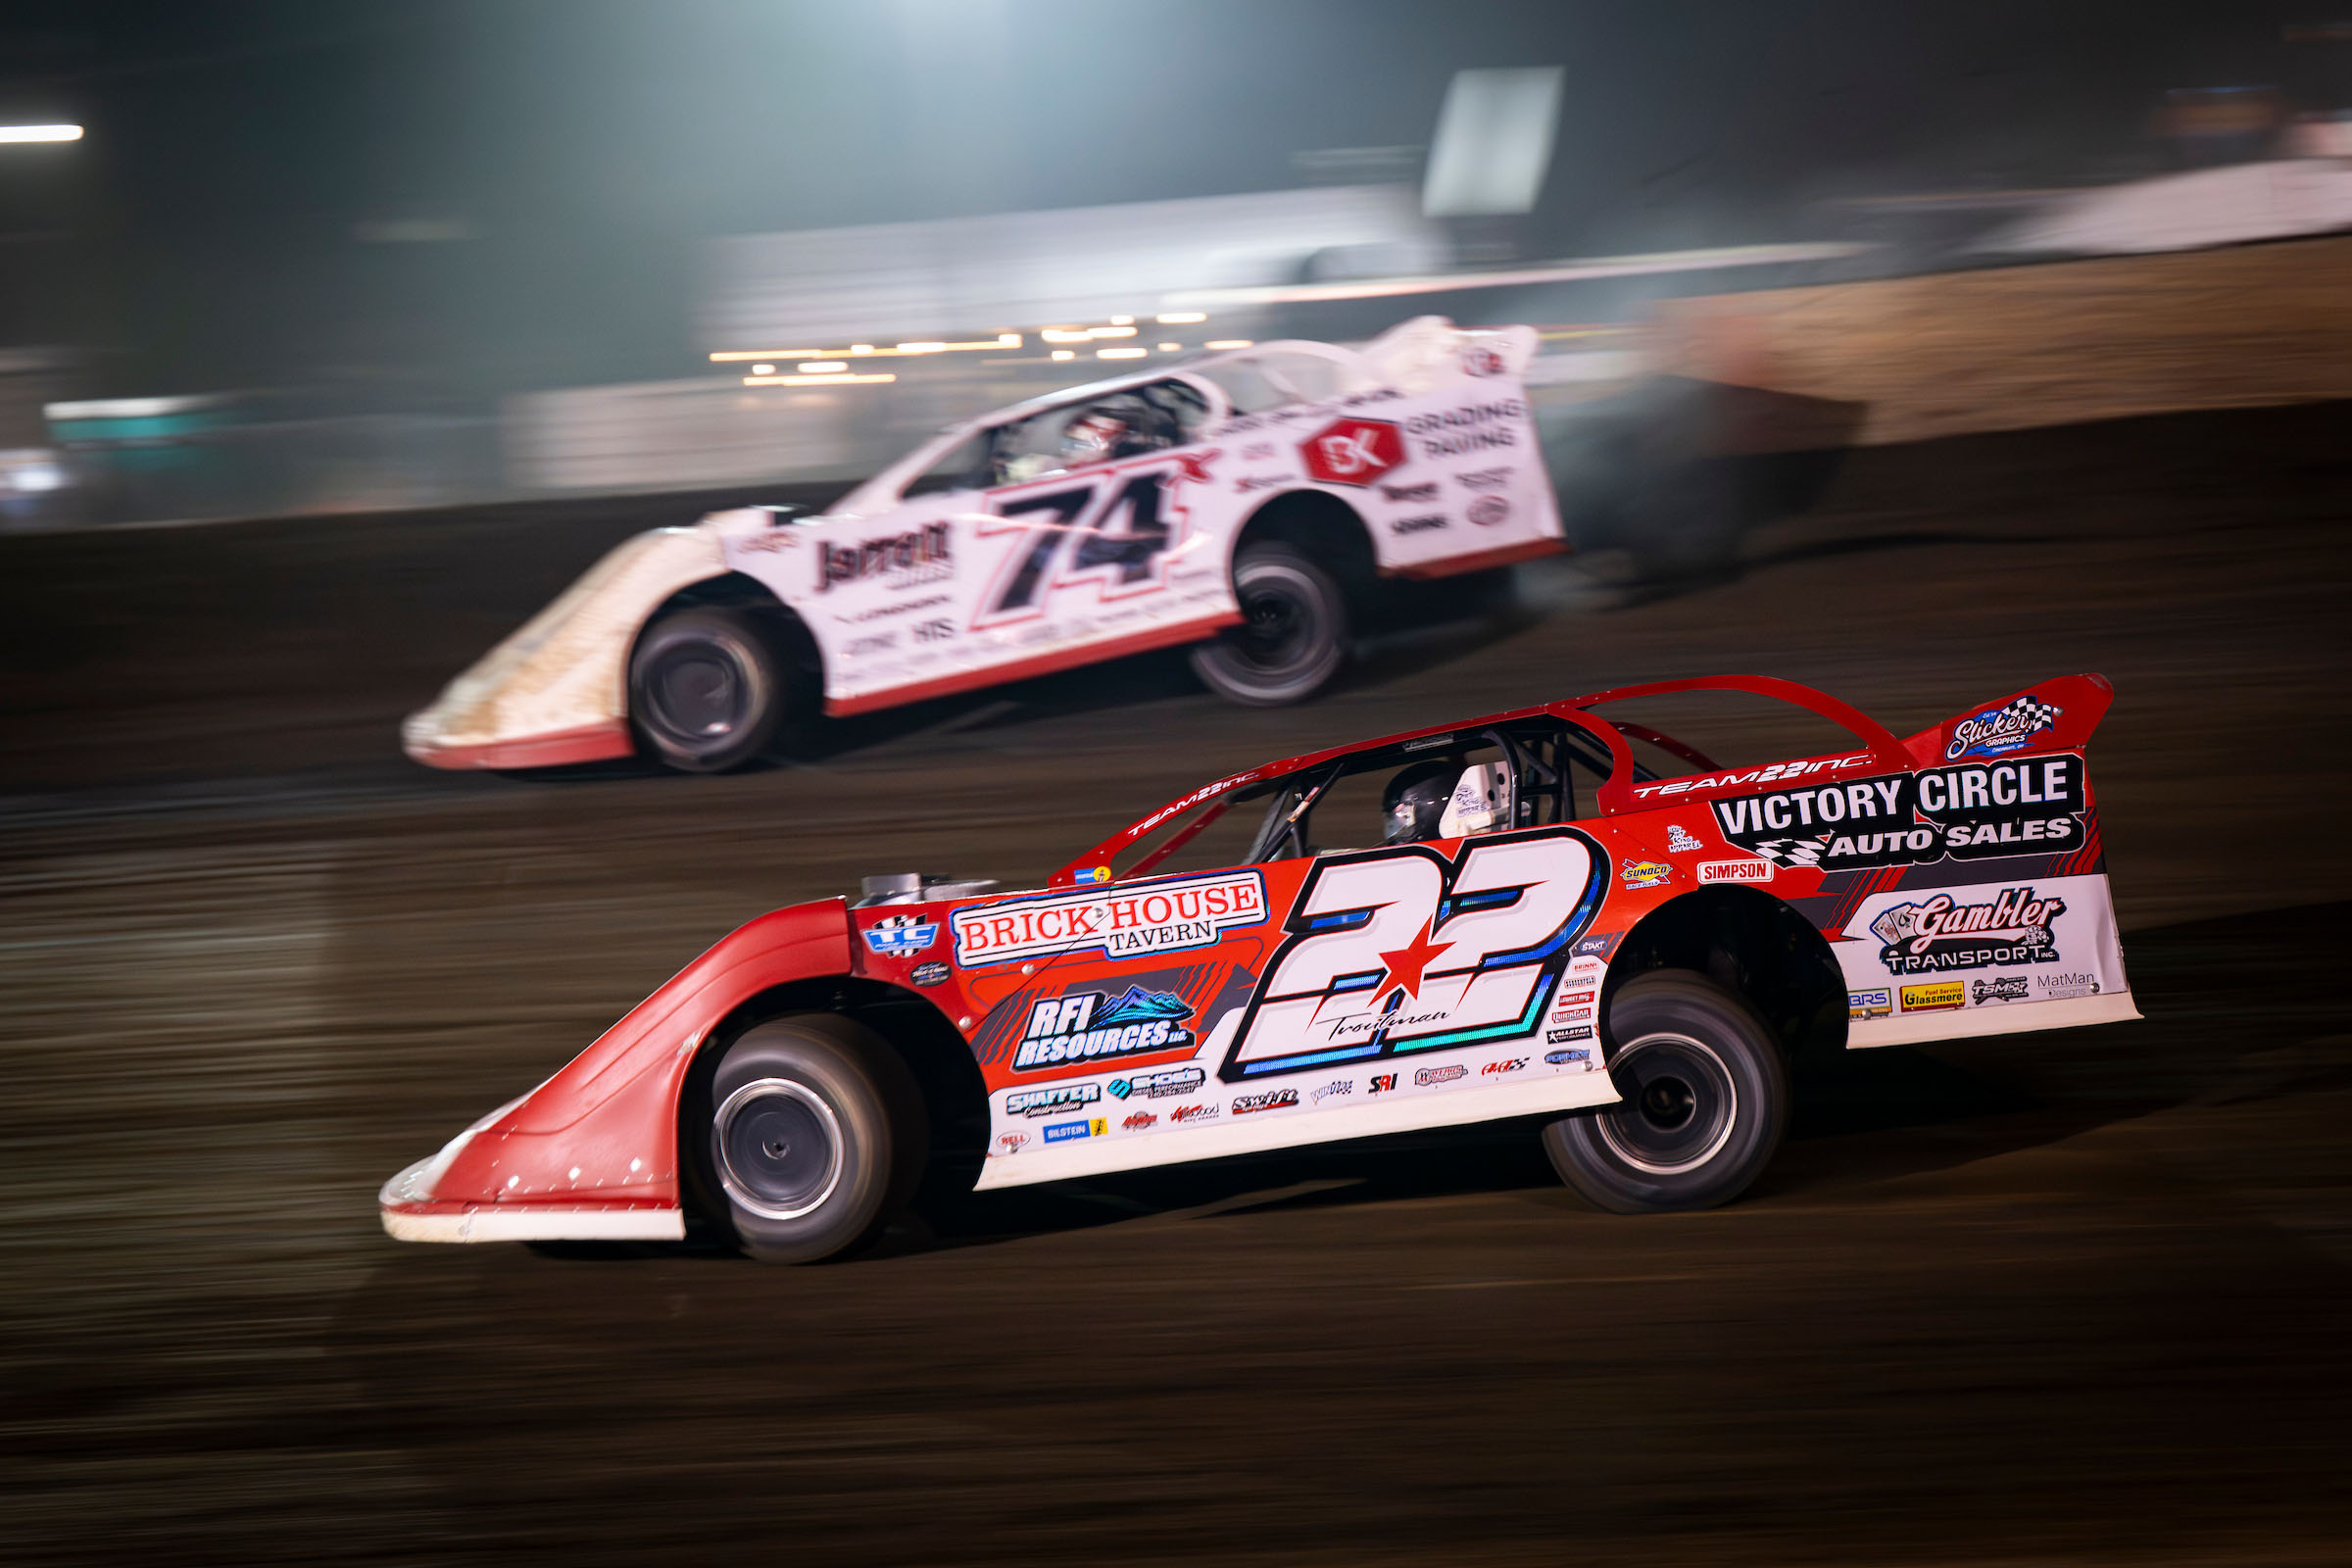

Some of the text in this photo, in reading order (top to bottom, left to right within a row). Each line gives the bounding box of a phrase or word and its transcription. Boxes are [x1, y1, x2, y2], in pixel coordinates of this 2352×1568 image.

[1985, 734, 2027, 747] GRAPHICS
[1718, 761, 2069, 835] VICTORY CIRCLE
[1828, 816, 2074, 858] AUTO SALES
[1626, 865, 1667, 878] SUNOCO
[1704, 862, 1767, 880] SIMPSON
[959, 881, 1258, 953] BRICK HOUSE
[1911, 886, 2062, 954] Gambler
[1109, 920, 1212, 952] TAVERN
[1220, 828, 1607, 1078] 22
[1886, 944, 2056, 971] TRANSPORT INC.
[2038, 972, 2094, 988] MatMan
[2049, 987, 2086, 999] Designs
[1904, 992, 1963, 1005] Glassmere
[1027, 996, 1097, 1039] RFI
[1315, 1009, 1451, 1041] Troutman
[1015, 1019, 1171, 1067] RESOURCES
[1368, 1073, 1398, 1095] SRI
[1006, 1084, 1099, 1113] SHAFFER
[1023, 1100, 1083, 1118] Construction
[1047, 1124, 1086, 1140] BILSTEIN
